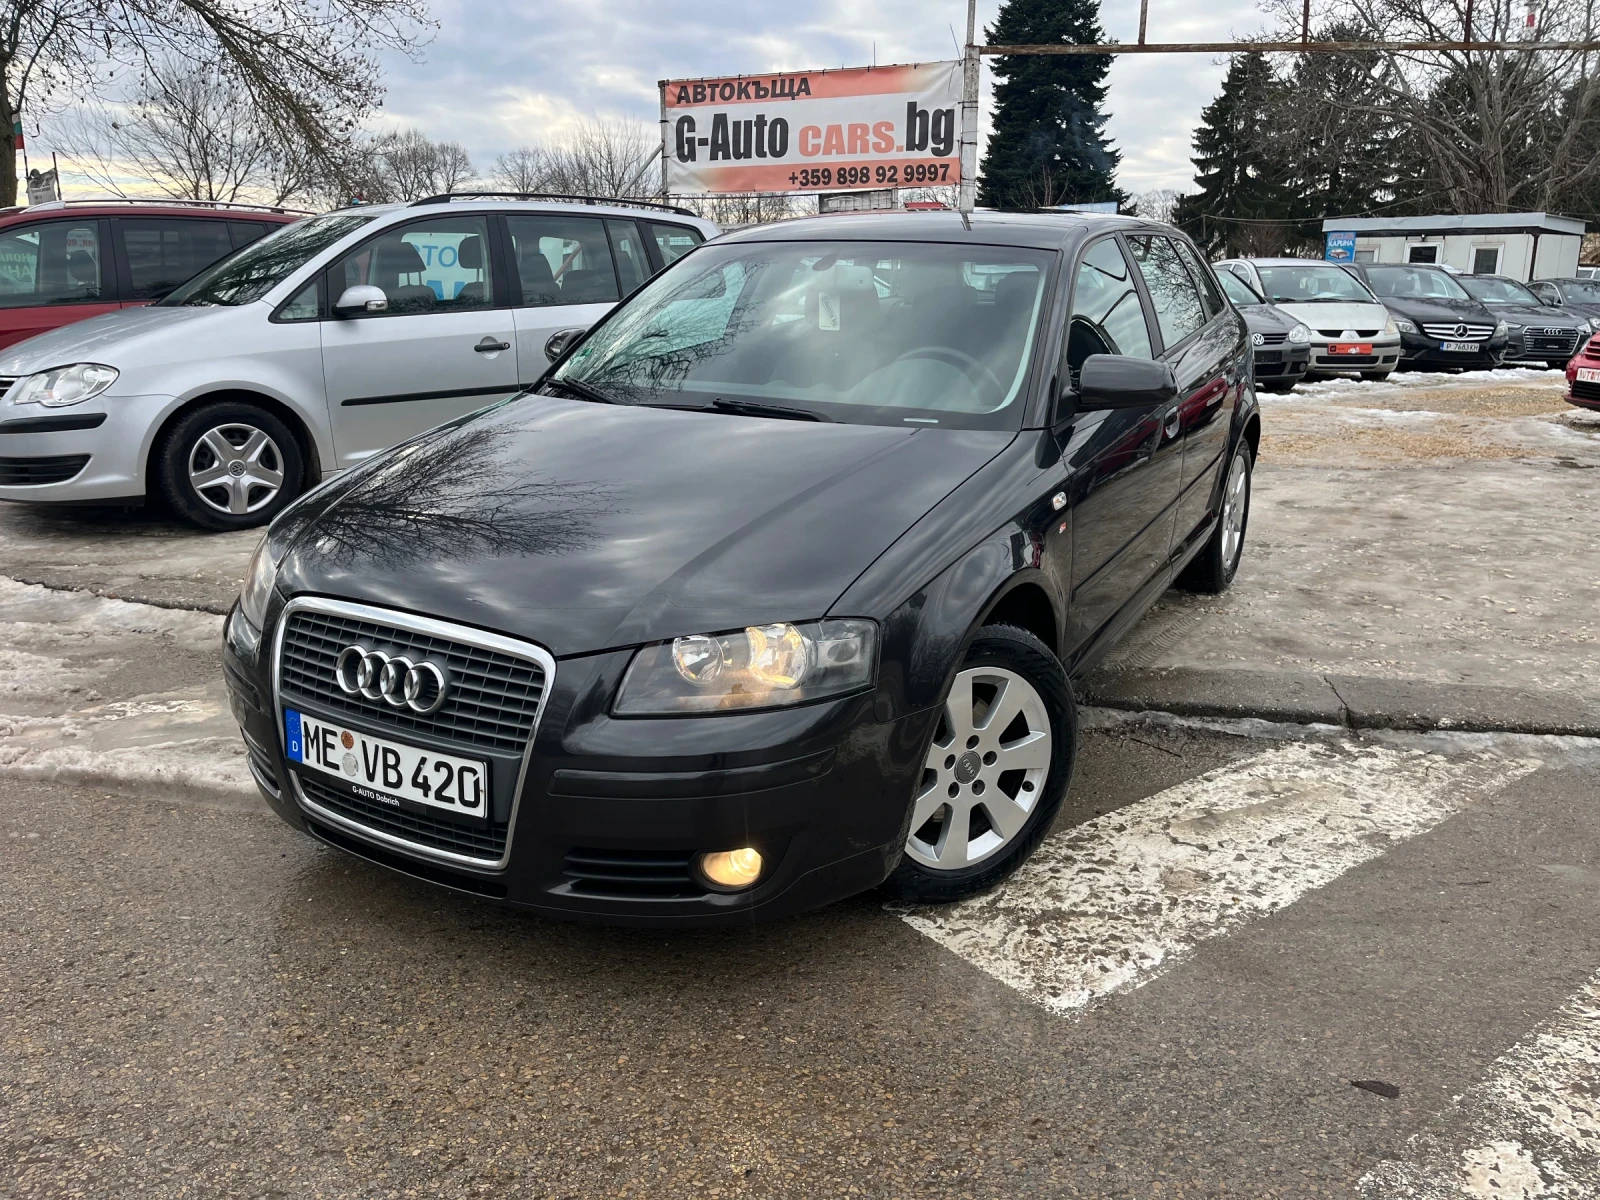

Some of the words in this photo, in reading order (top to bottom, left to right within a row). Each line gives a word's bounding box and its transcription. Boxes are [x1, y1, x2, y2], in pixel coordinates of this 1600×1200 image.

[676, 77, 812, 105] АВТОКЪЩА
[675, 112, 790, 163] G-Auto
[789, 167, 832, 187] +359
[837, 166, 871, 185] 898
[875, 165, 898, 183] 92
[903, 163, 951, 183] 9997
[292, 741, 299, 752] D
[303, 720, 341, 771] ME
[361, 739, 404, 789] VB
[411, 756, 482, 809] 420
[352, 785, 375, 799] G-AUTO
[375, 793, 400, 807] Dobrich
